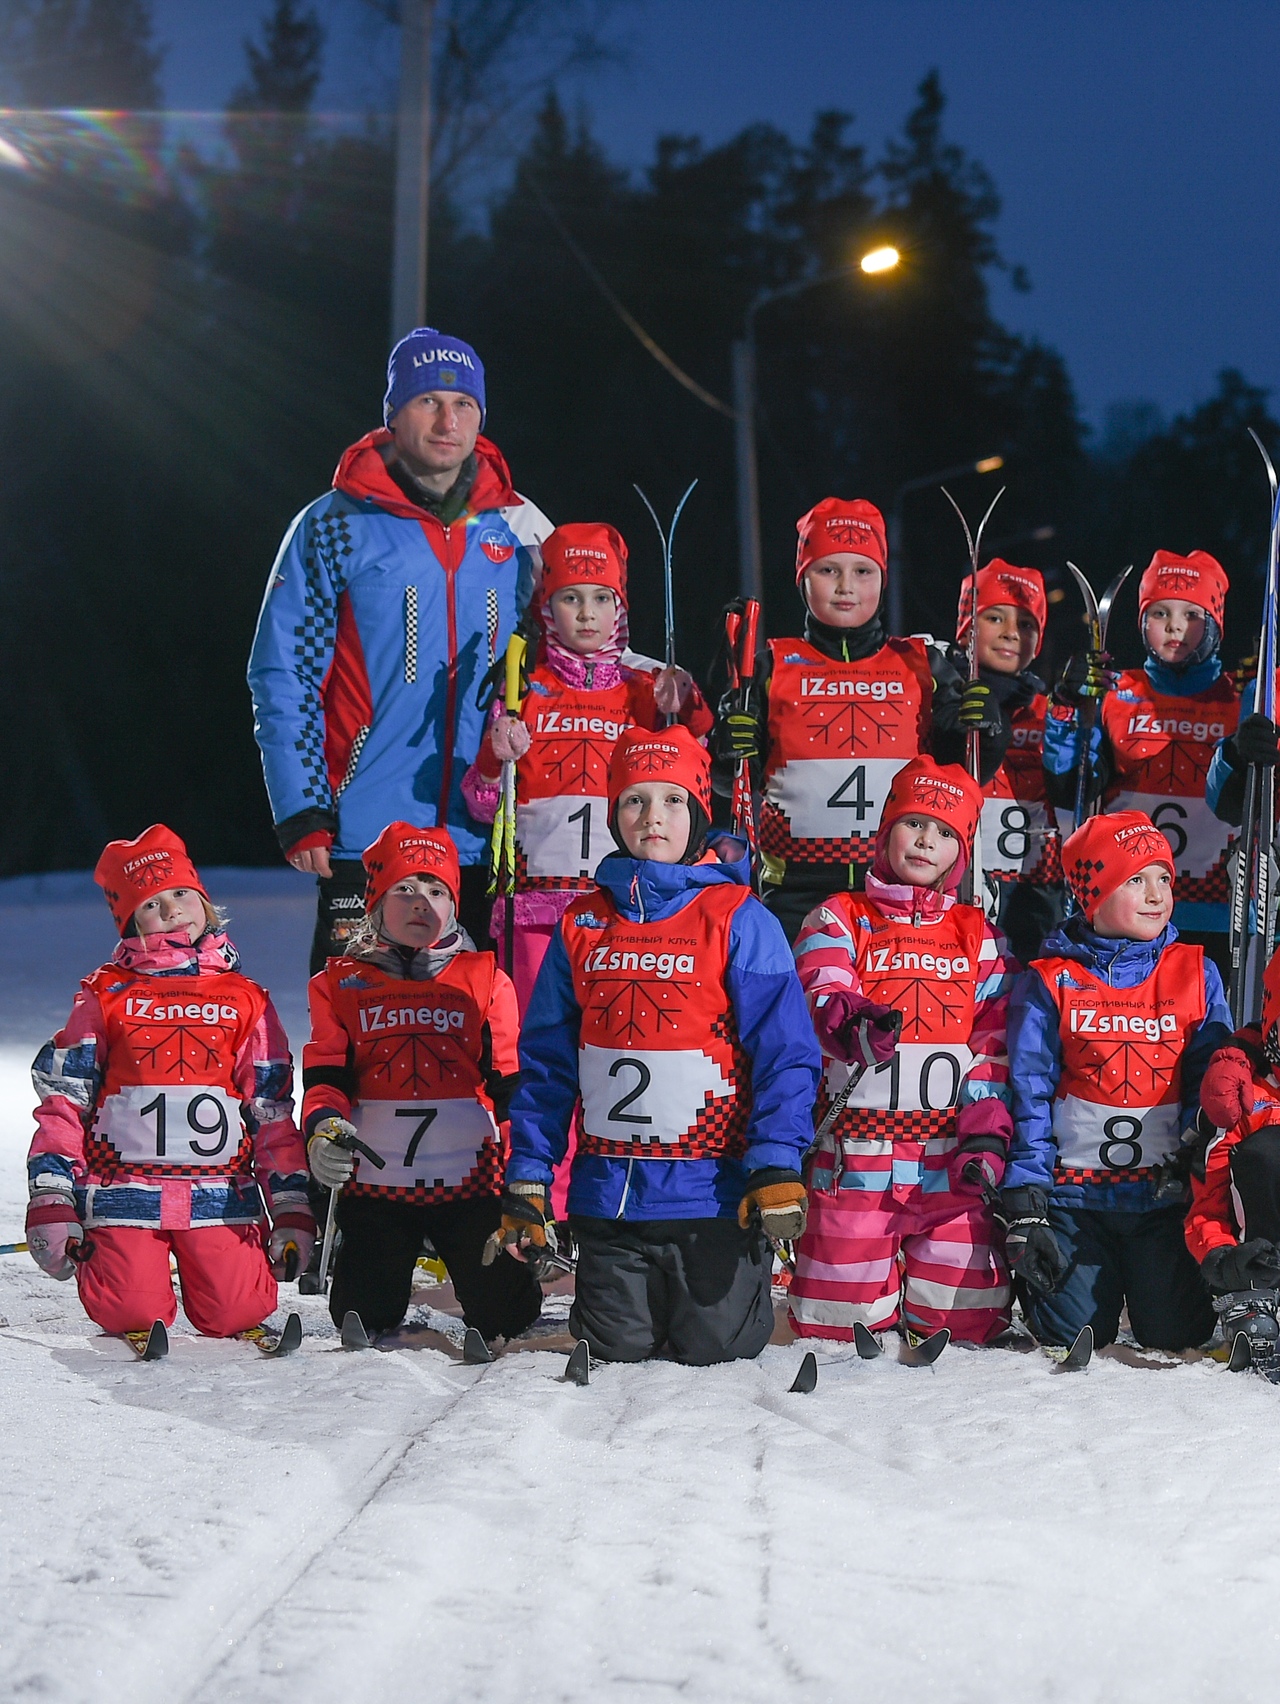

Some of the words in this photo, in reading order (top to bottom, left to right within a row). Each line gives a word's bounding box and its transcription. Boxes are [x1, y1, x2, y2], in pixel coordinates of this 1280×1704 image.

[412, 349, 475, 371] LUKOIL
[801, 678, 904, 701] IZsnega
[1127, 714, 1225, 741] IZsnega
[827, 765, 874, 821] 4
[914, 776, 964, 797] IZsnega
[568, 802, 592, 859] 1
[997, 805, 1032, 859] 8
[1151, 802, 1188, 858] 6
[1233, 851, 1246, 934] MARPETTI
[1256, 851, 1269, 936] MARPETTI
[668, 938, 698, 946] КЛУБ
[584, 946, 695, 979] IZsnega
[865, 947, 970, 980] IZsnega
[125, 997, 239, 1024] IZsnega
[208, 993, 238, 1001] КЛУБ
[1069, 999, 1146, 1009] СПОРТИВНЫЙ
[359, 1004, 465, 1033] IZsnega
[1069, 1009, 1178, 1041] IZsnega
[608, 1057, 653, 1124] 2
[874, 1051, 961, 1110] 10
[140, 1093, 229, 1157] 19
[394, 1108, 438, 1168] 7
[1098, 1114, 1143, 1170] 8
